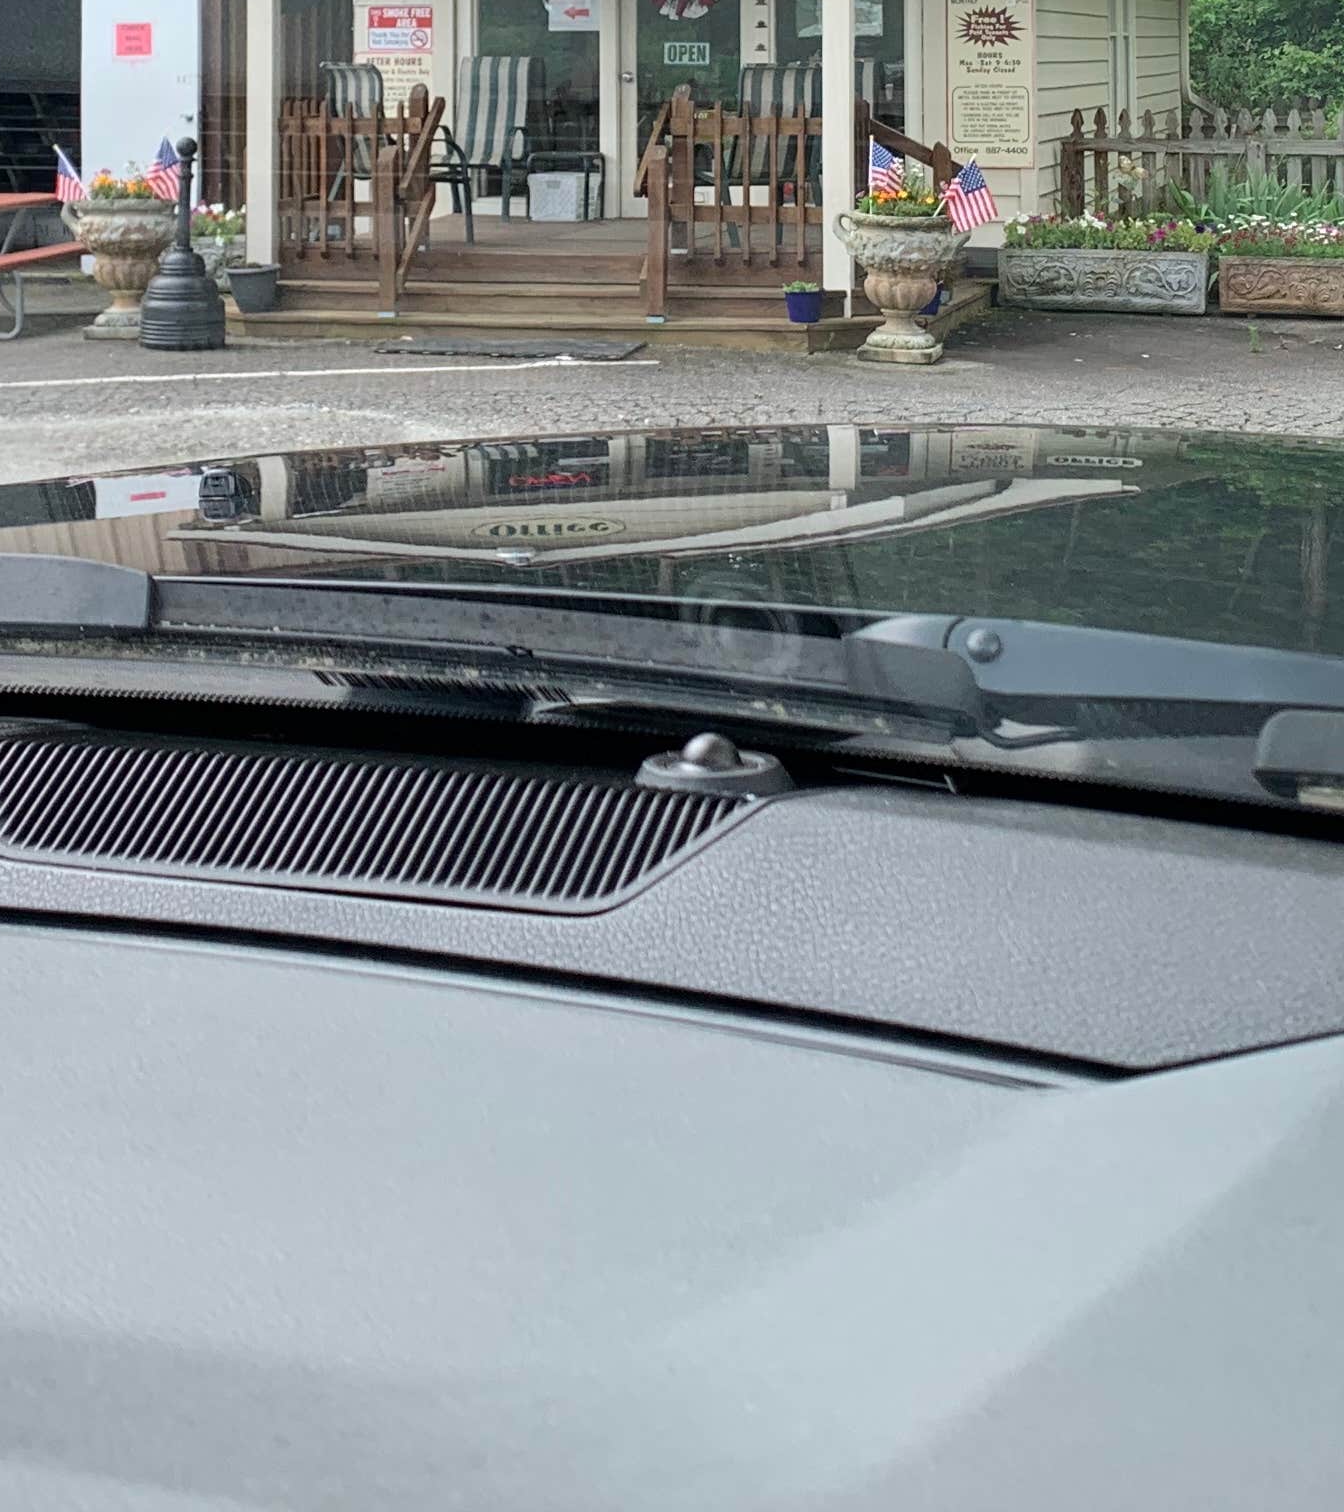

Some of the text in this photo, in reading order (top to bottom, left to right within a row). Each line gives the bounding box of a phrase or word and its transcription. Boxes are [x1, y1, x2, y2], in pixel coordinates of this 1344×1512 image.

[383, 8, 409, 18] SMOKE
[410, 8, 431, 18] FREE
[396, 18, 417, 26] AREA
[667, 44, 707, 62] OPEN
